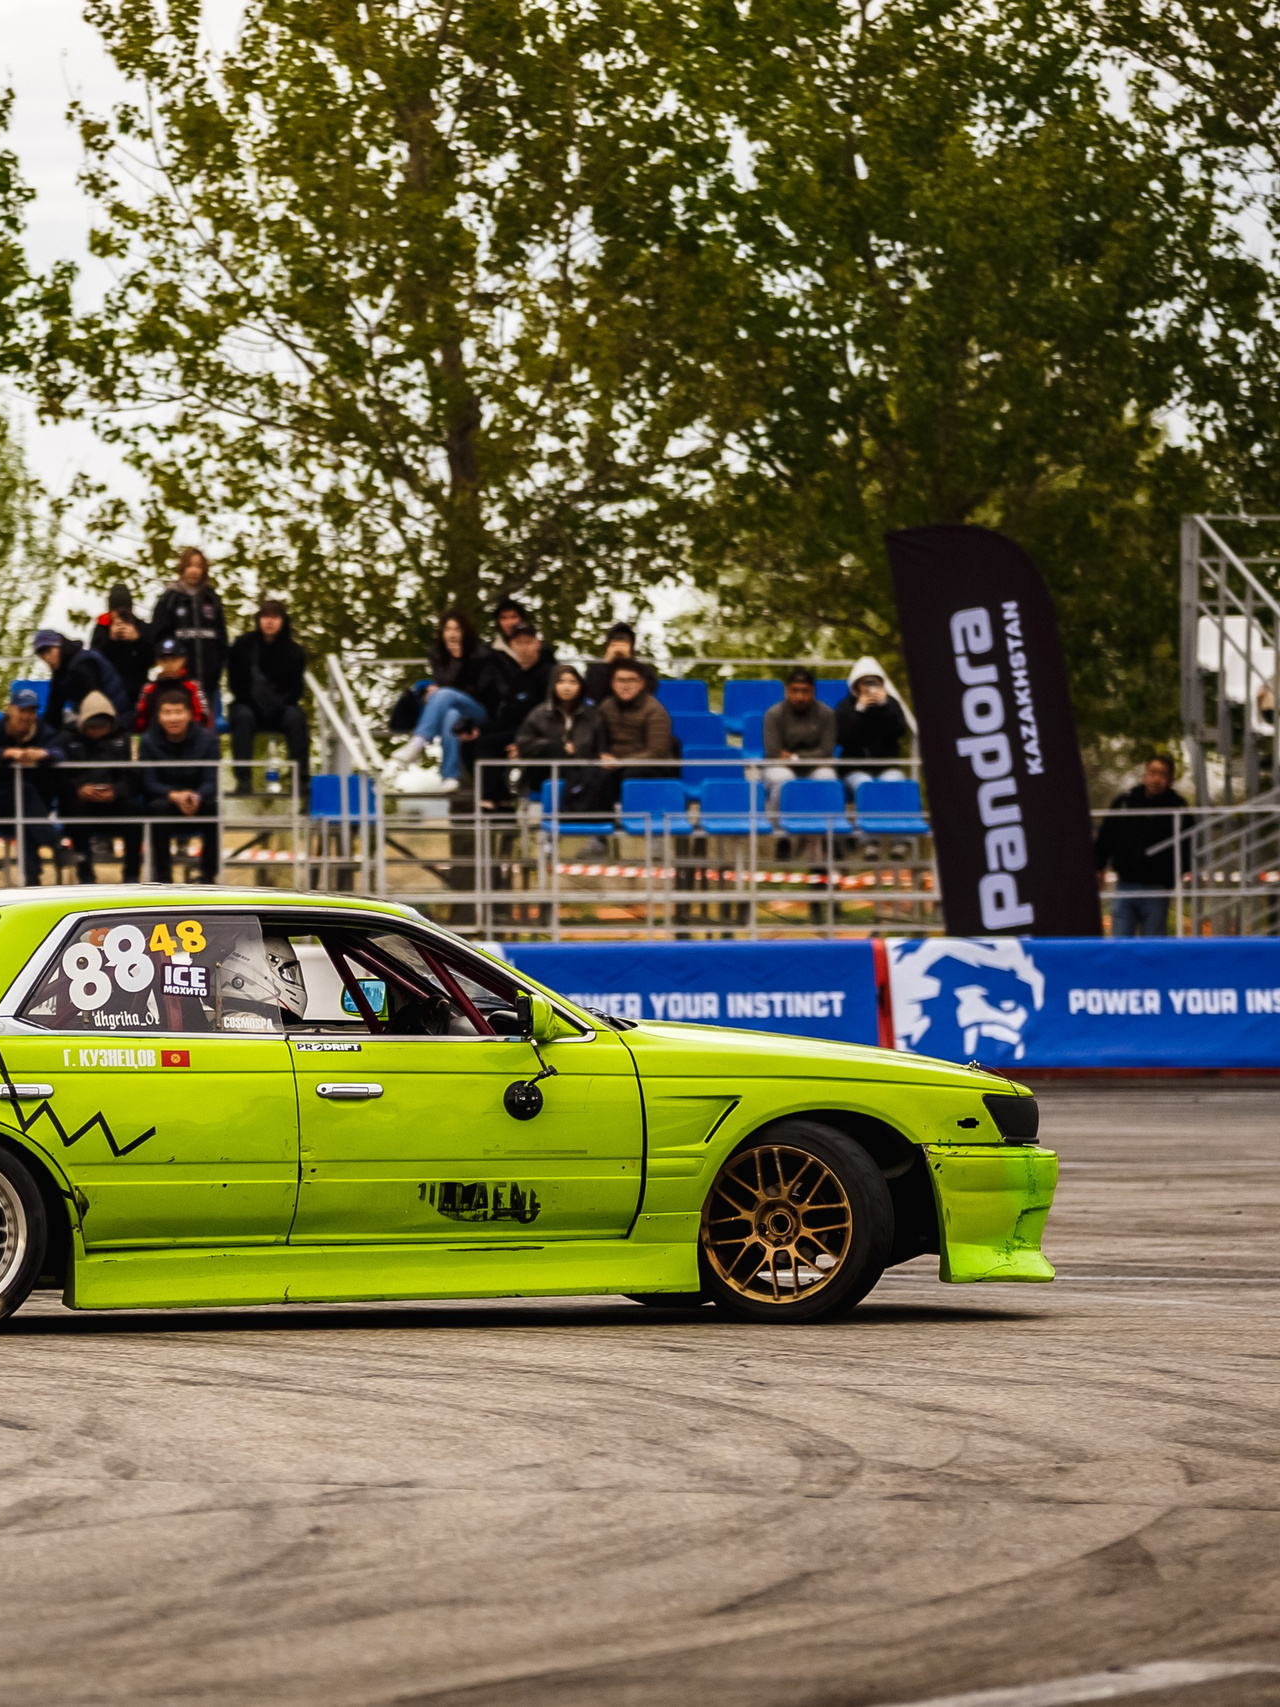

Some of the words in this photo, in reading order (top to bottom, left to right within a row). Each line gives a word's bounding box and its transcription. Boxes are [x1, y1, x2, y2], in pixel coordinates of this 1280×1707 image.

[1001, 600, 1045, 775] KAZAKHSTAN
[950, 606, 1035, 930] pandora
[149, 920, 207, 957] 48
[62, 924, 155, 1011] 88
[164, 965, 206, 988] ICE
[163, 985, 208, 996] МОХИТО
[1068, 988, 1161, 1015] POWER
[1168, 988, 1238, 1015] YOUR
[649, 992, 720, 1020] YOUR
[726, 992, 845, 1018] INSTINCT
[223, 1017, 274, 1030] COSMOSPA
[63, 1049, 76, 1067] Г.
[79, 1049, 156, 1069] КУЗНЕЦОВ
